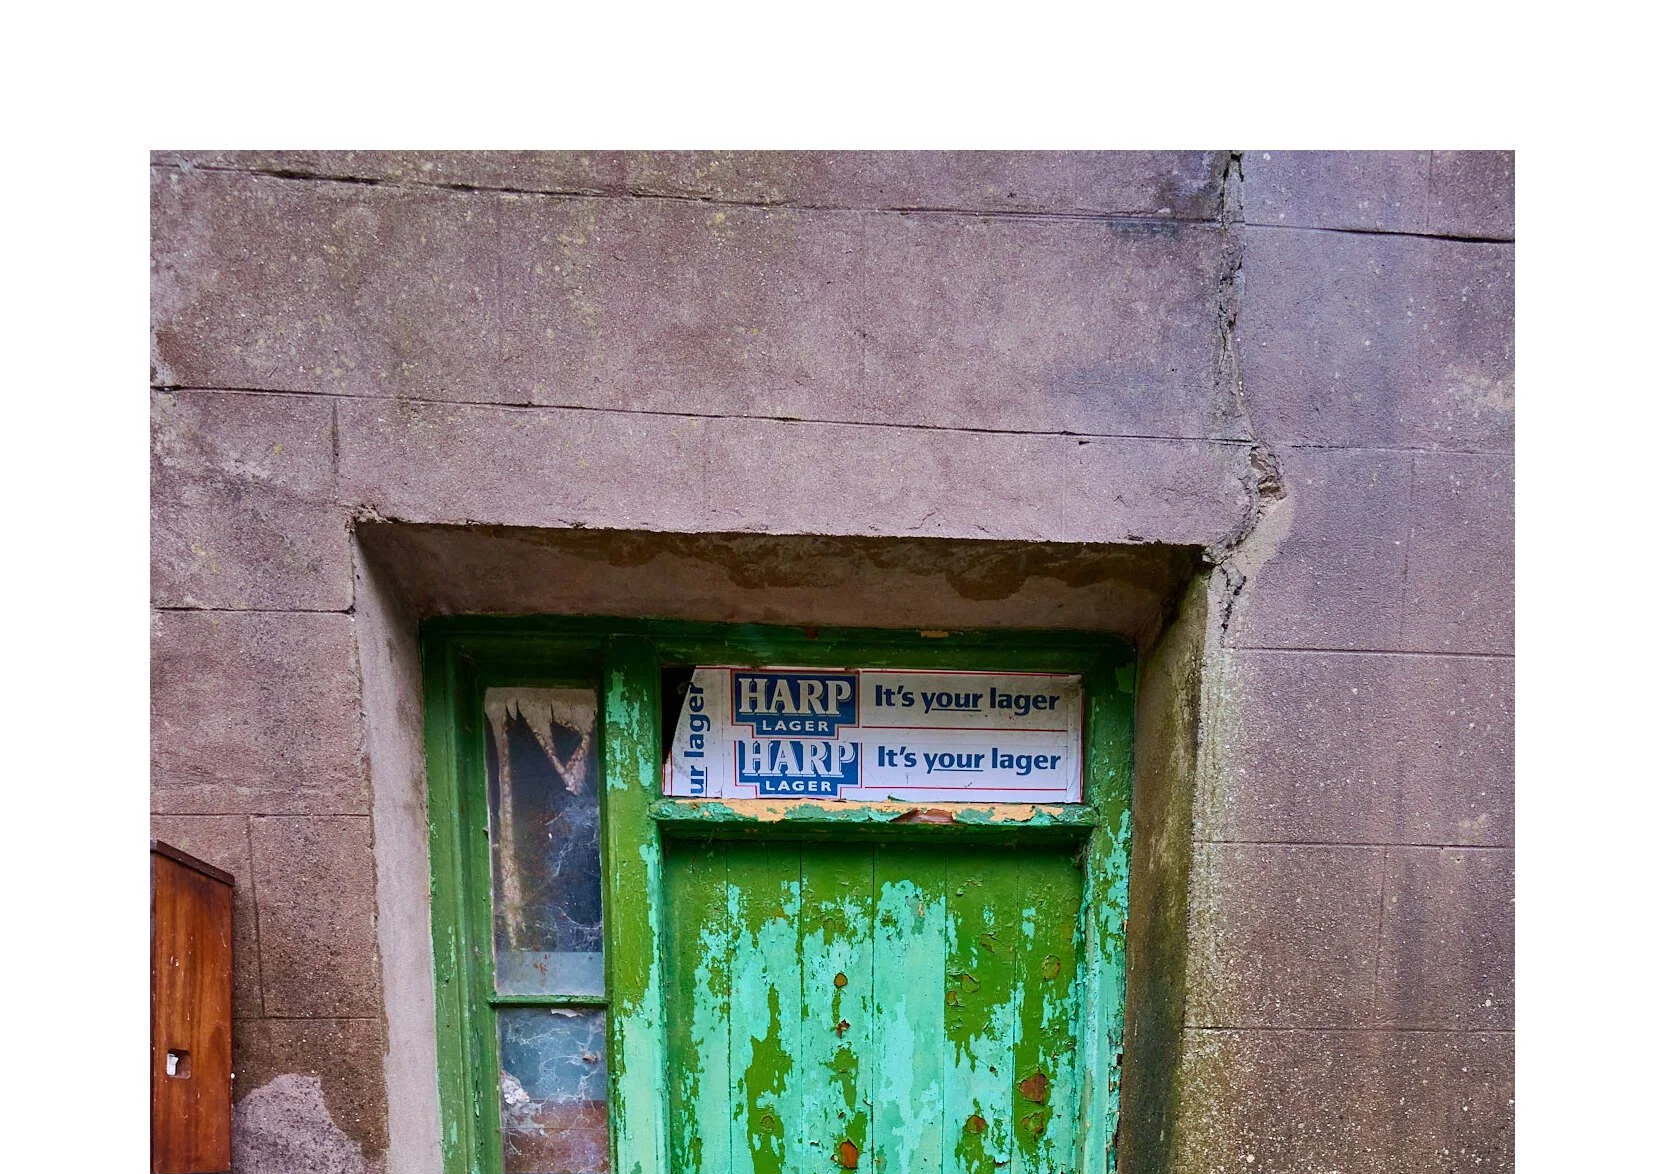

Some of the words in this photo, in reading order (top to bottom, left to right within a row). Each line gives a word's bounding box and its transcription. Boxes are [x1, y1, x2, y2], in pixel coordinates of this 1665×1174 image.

[738, 678, 852, 716] HARP
[875, 684, 915, 708] It's
[921, 690, 984, 714] your
[989, 687, 1060, 716] lager
[683, 682, 710, 758] lager
[762, 719, 829, 732] LAGER
[742, 740, 856, 778] HARP
[877, 746, 917, 768] It's
[923, 751, 985, 775] your
[991, 747, 1061, 776] lager
[765, 780, 832, 792] LAGER
